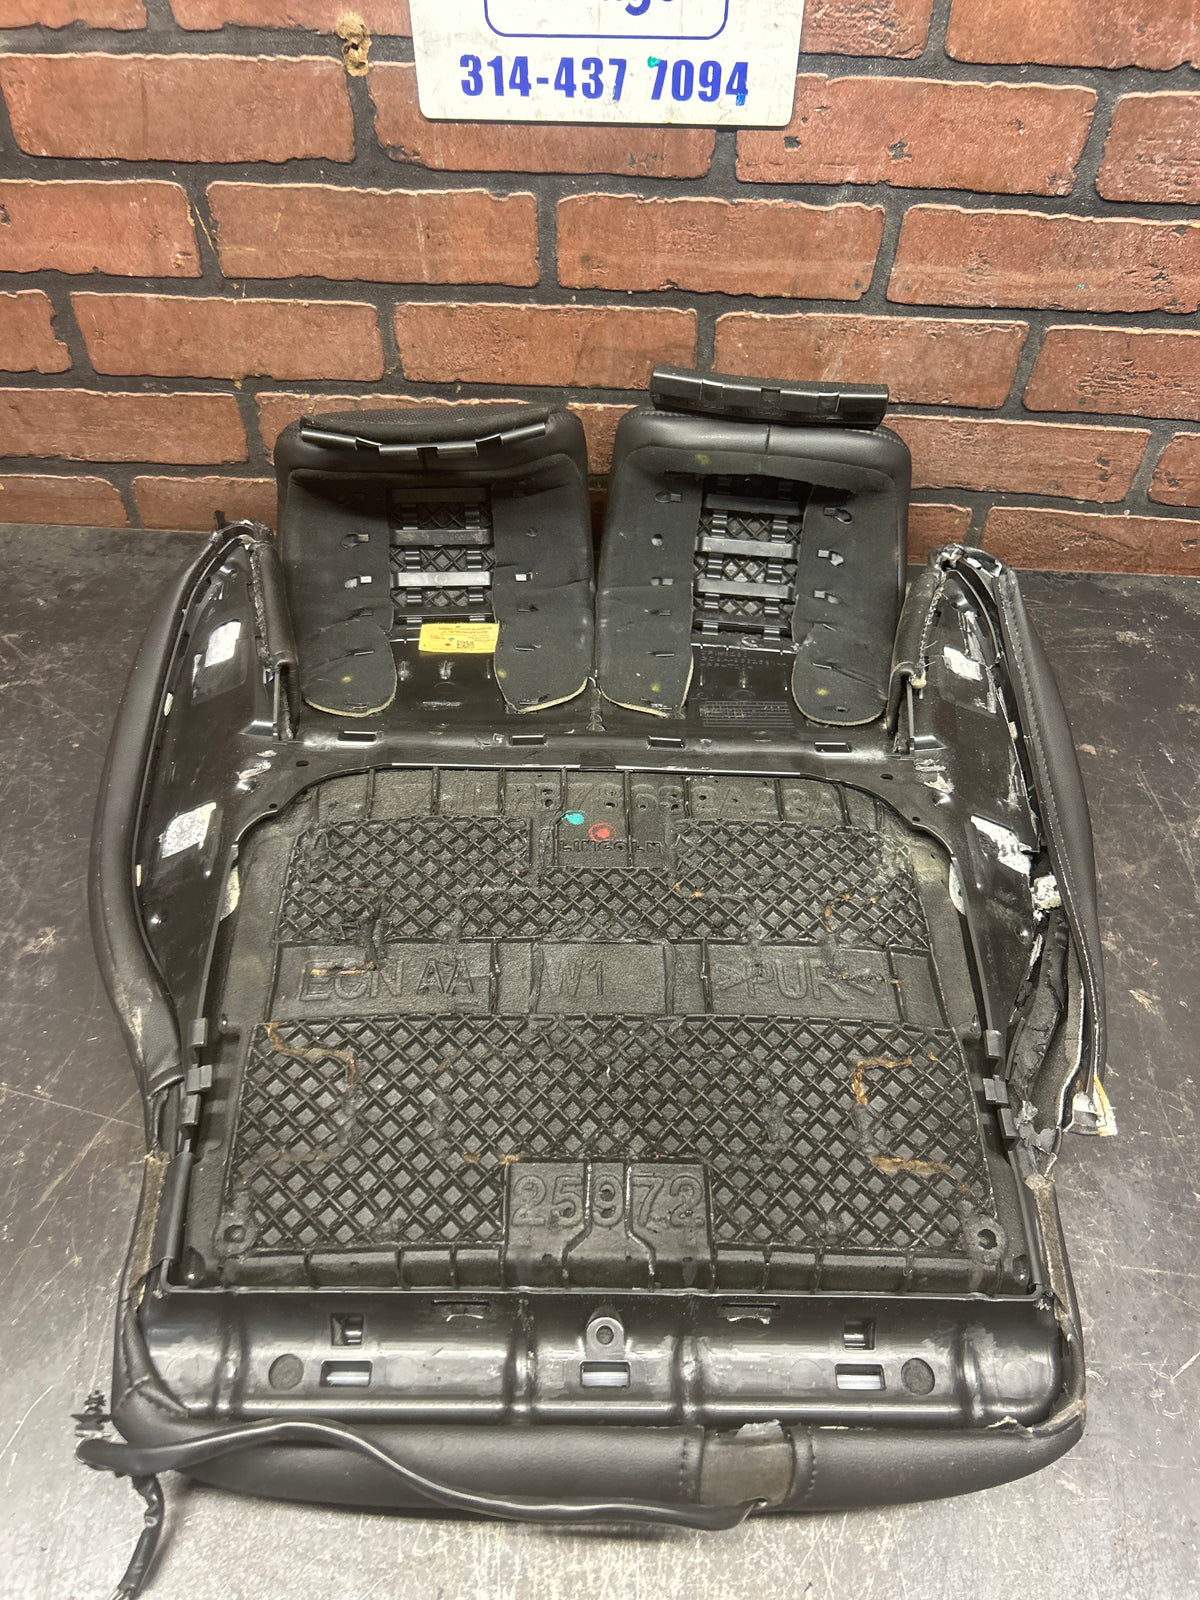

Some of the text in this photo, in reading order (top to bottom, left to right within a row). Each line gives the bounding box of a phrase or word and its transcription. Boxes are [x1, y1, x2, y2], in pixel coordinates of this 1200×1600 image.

[459, 54, 749, 104] 314-437 7094
[510, 1173, 705, 1228] 25972
